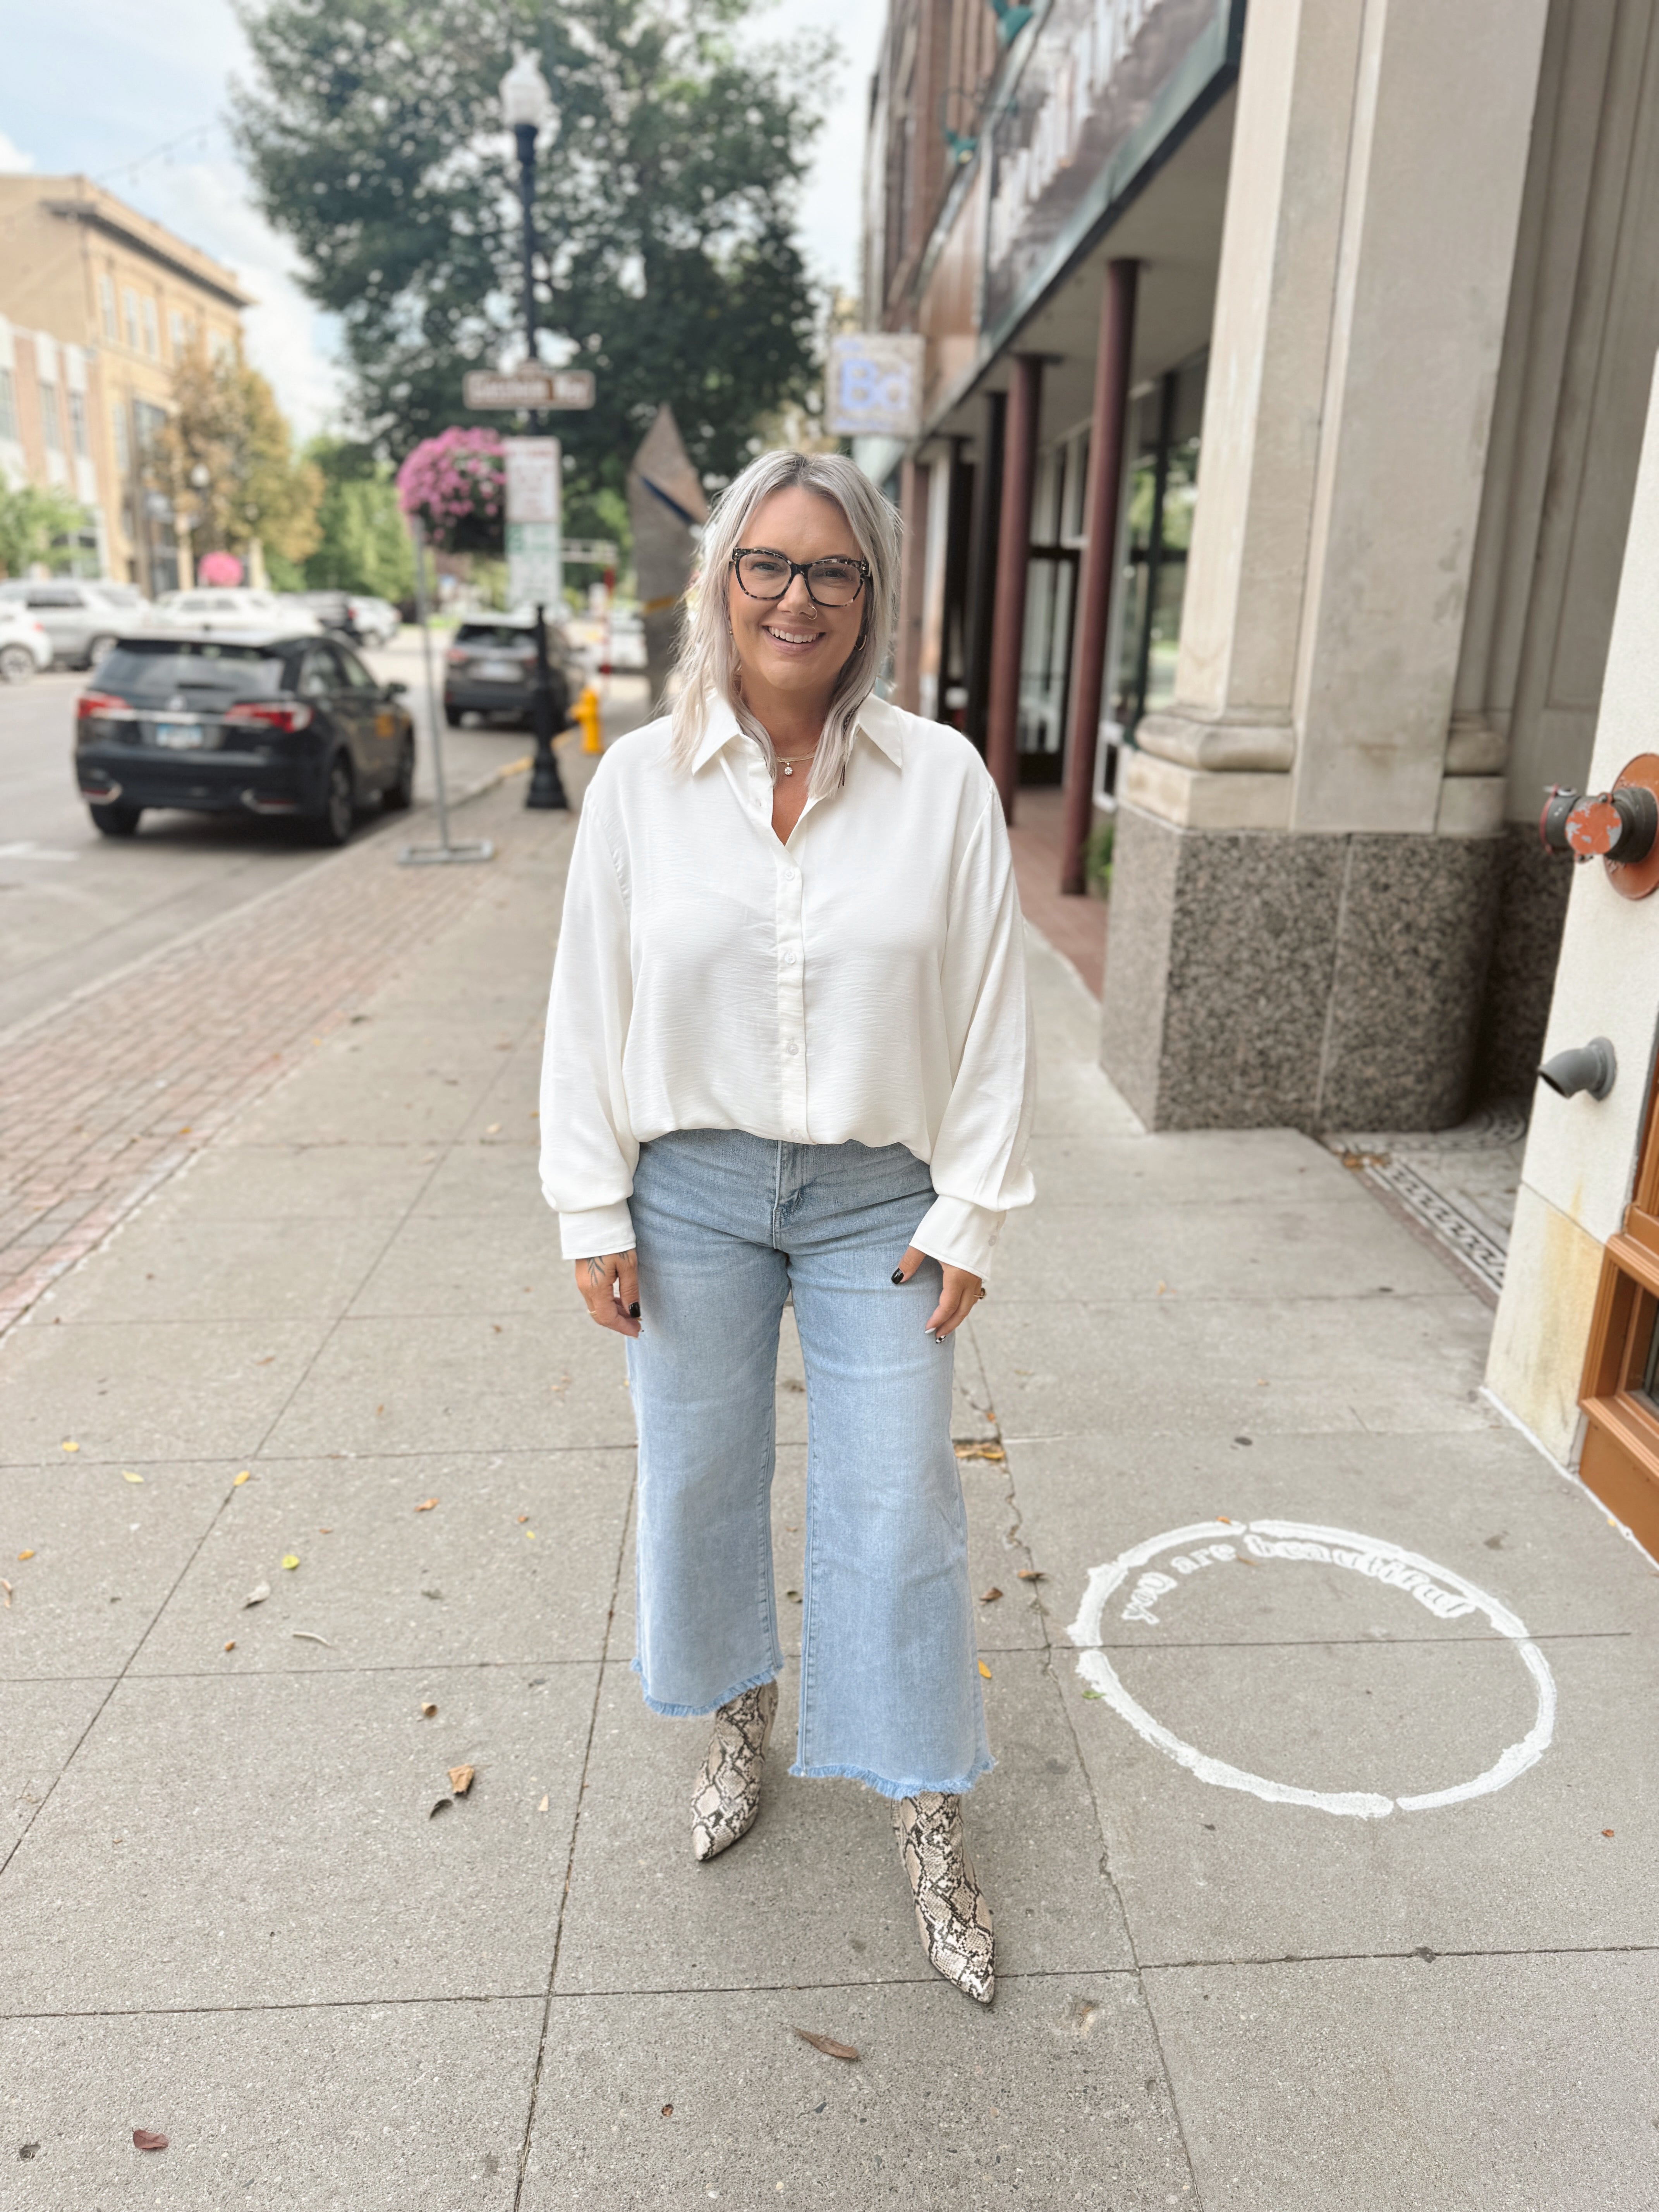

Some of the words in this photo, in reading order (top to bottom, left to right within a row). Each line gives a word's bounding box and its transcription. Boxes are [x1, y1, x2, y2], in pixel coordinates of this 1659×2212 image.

[1121, 1571, 1178, 1625] you
[1170, 1544, 1237, 1574] are
[1244, 1534, 1476, 1619] beautiful
